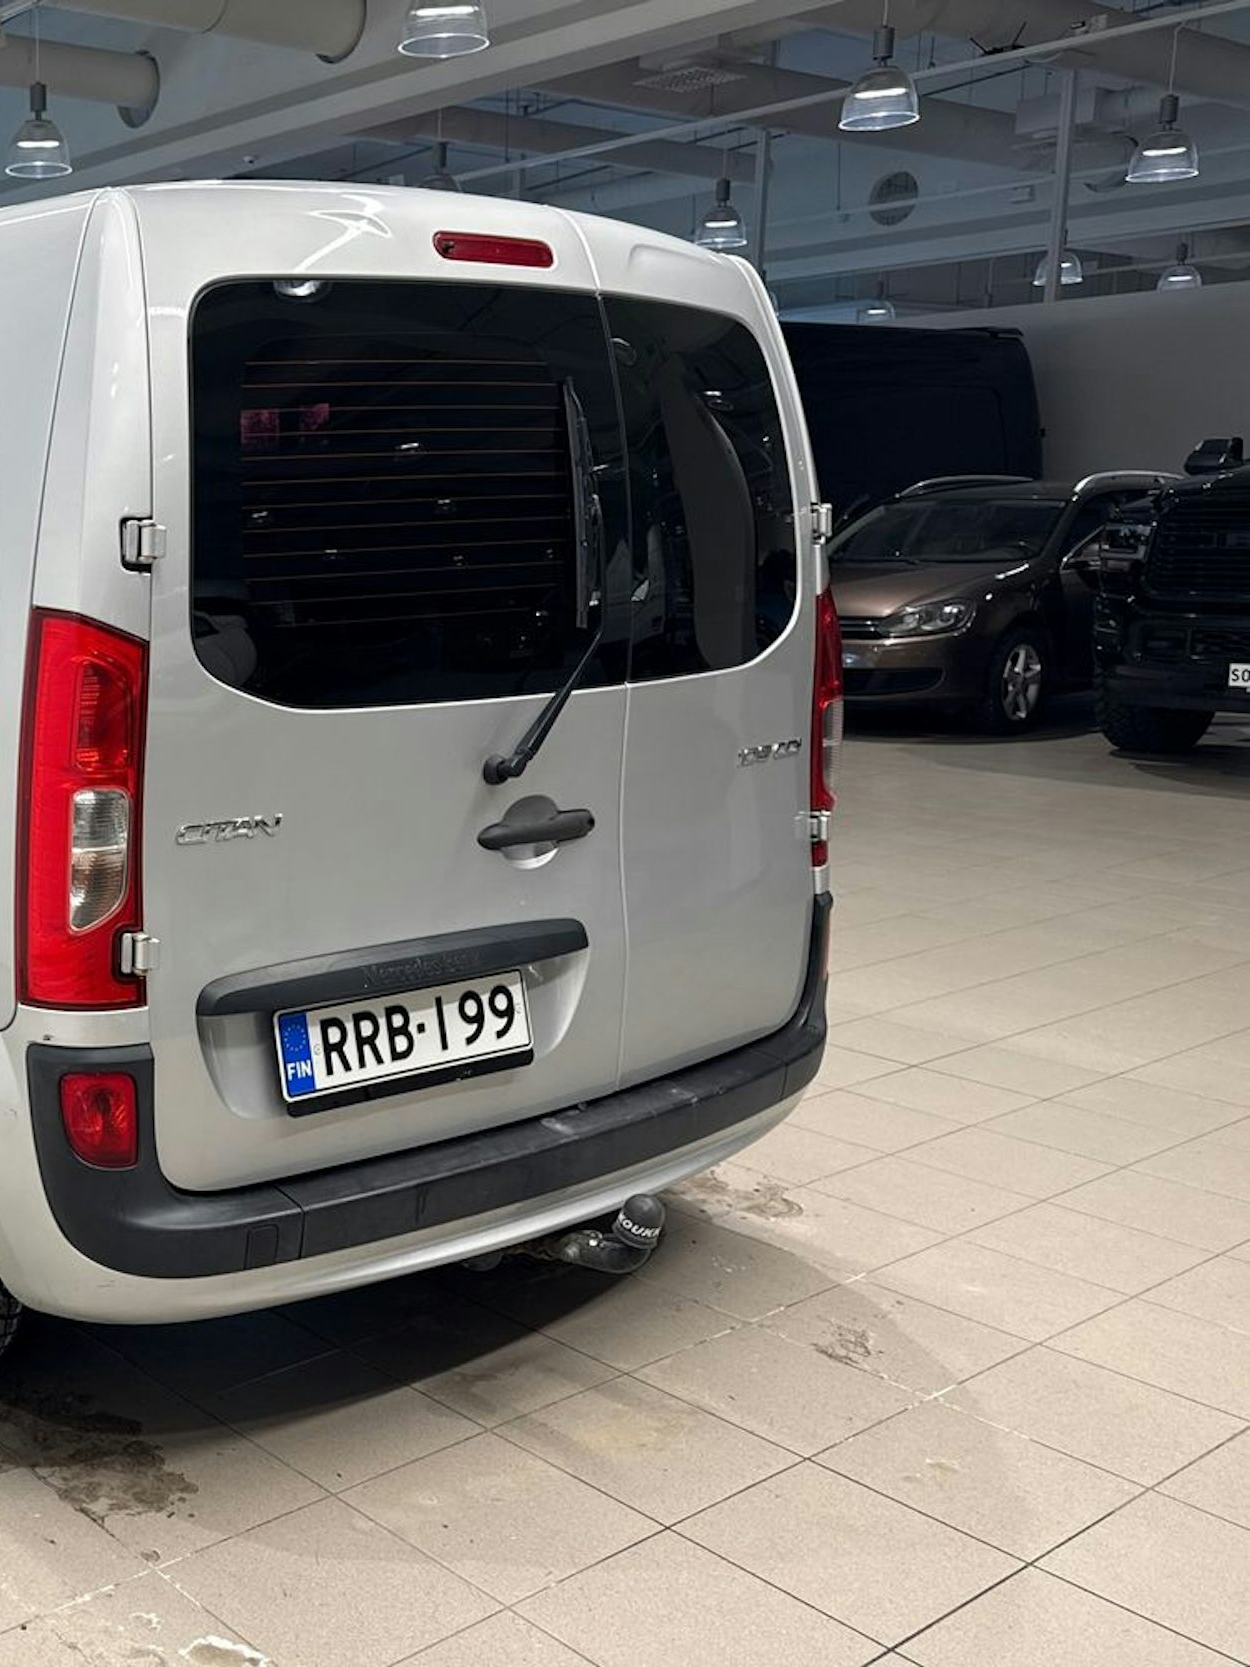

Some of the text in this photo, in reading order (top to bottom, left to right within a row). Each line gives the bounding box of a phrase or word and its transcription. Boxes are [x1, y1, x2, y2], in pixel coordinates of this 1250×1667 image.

[175, 812, 283, 845] CITAN
[319, 985, 515, 1076] RRB-199
[286, 1060, 312, 1081] FIN
